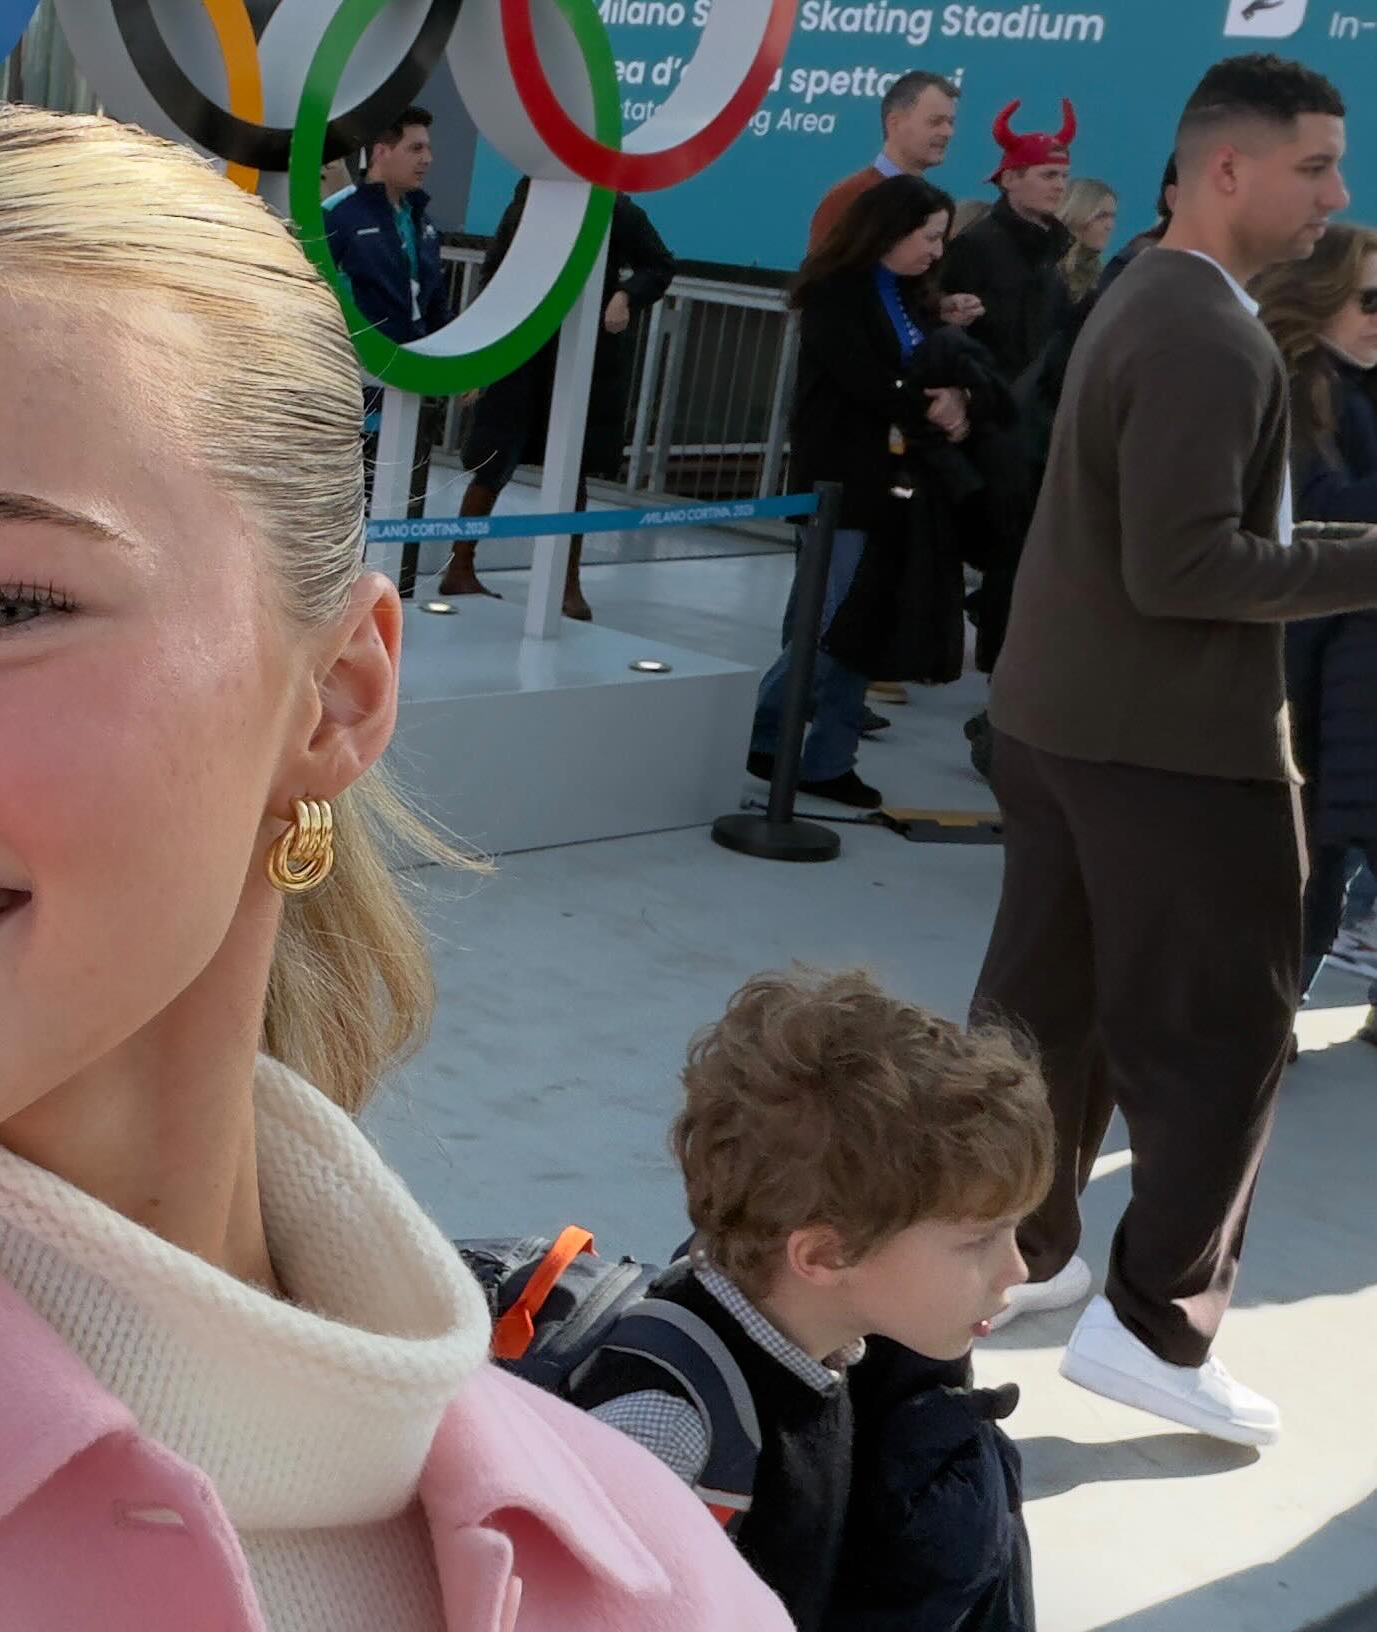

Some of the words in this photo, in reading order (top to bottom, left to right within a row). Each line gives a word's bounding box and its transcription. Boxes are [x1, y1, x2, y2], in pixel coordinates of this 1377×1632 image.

[800, 0, 933, 45] Skating
[941, 3, 1105, 41] Stadium
[776, 108, 836, 134] Area
